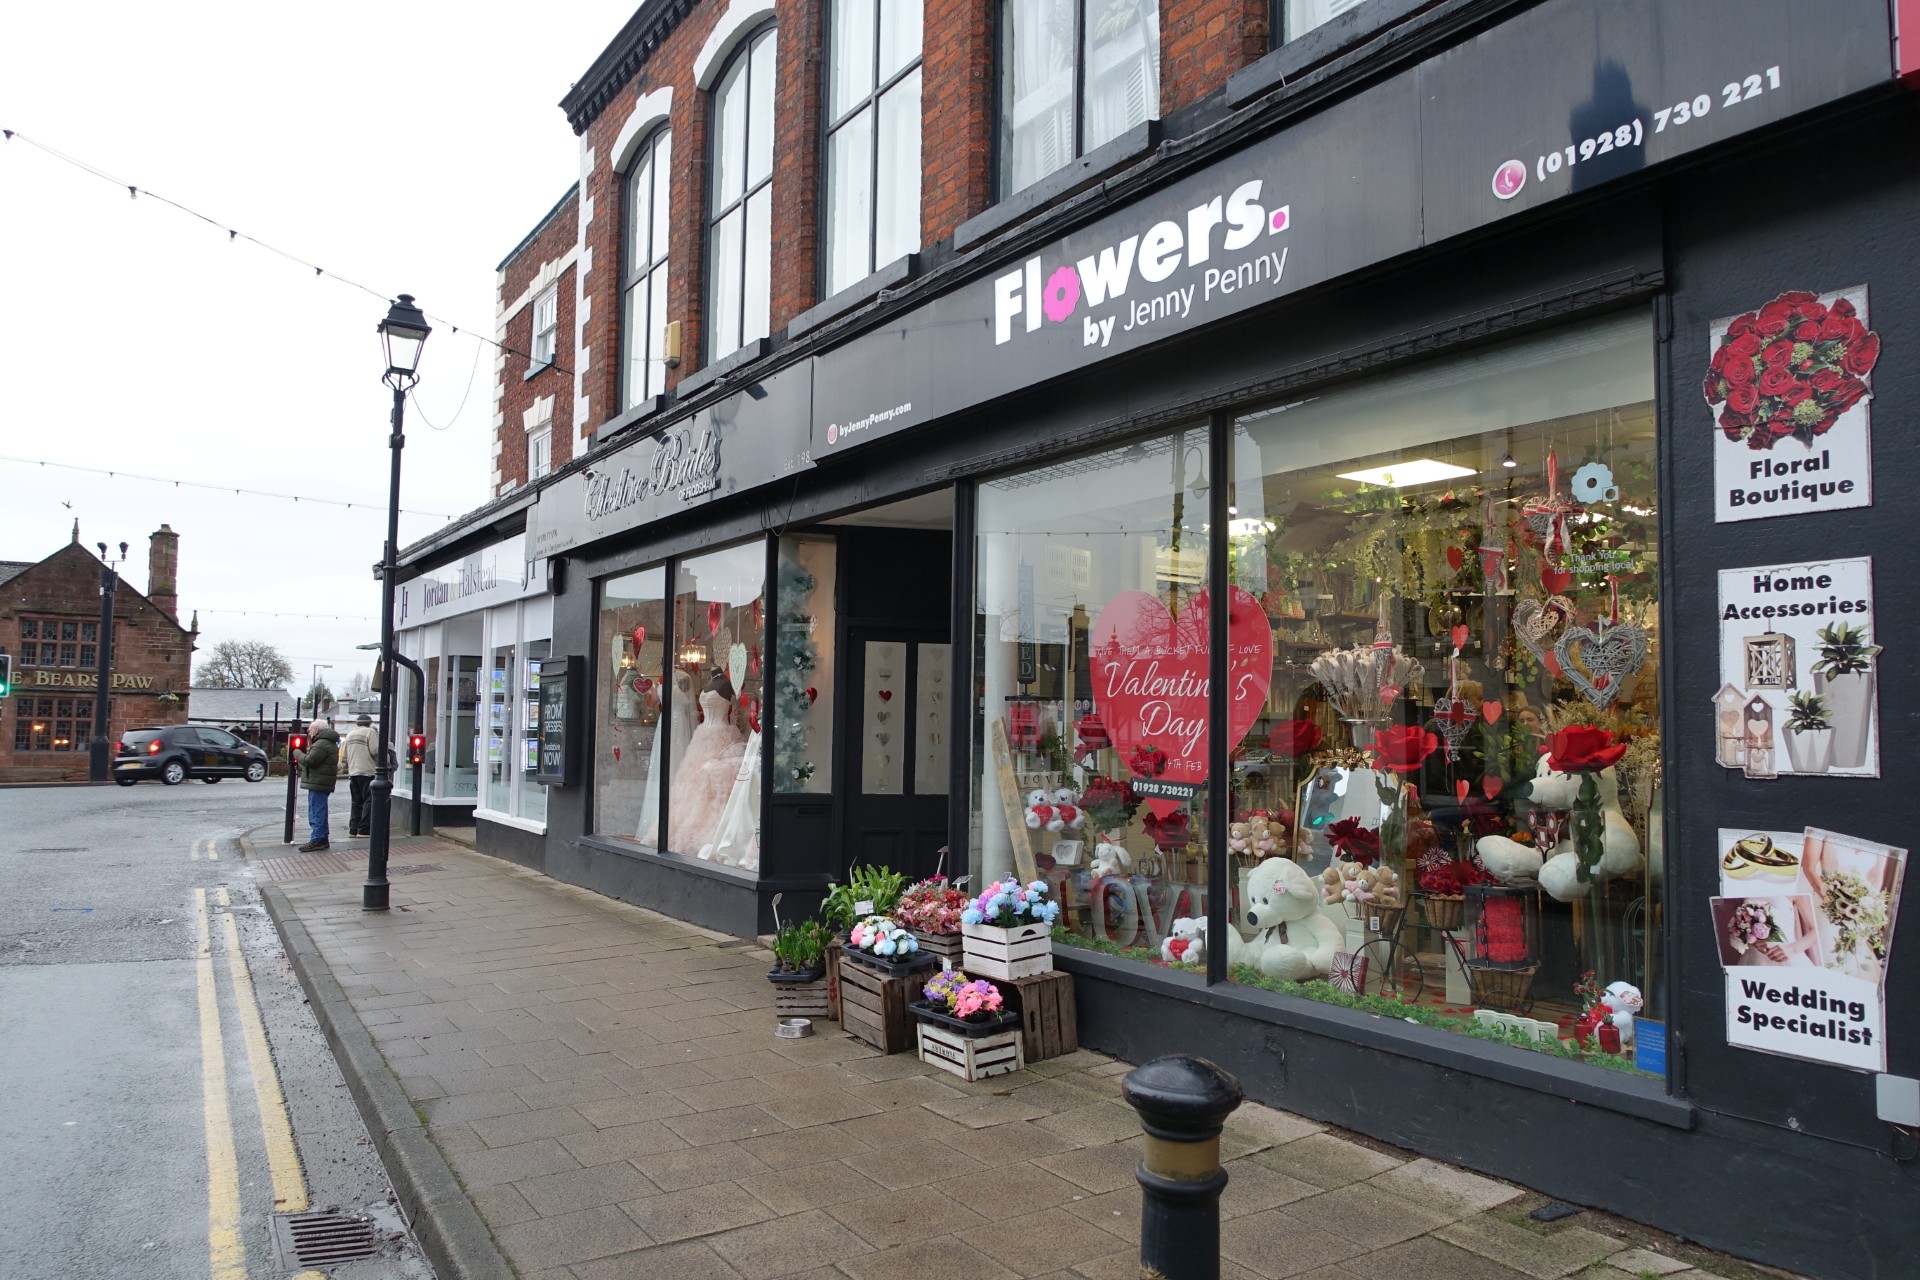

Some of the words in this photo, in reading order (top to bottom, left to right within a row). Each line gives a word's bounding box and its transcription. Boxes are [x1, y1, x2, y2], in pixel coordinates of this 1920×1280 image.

[1536, 118, 1644, 182] (01928)
[1653, 94, 1712, 134] 730
[1721, 65, 1781, 109] 221
[1083, 316, 1116, 348] by
[1124, 284, 1196, 331] Jenny
[1204, 247, 1289, 302] Penny
[839, 402, 912, 437] byJennyPenny.com
[1749, 450, 1831, 480] Floral
[1729, 478, 1855, 508] Boutique
[1554, 565, 1567, 575] for
[1569, 562, 1610, 576] shopping
[1611, 559, 1634, 570] local
[1570, 552, 1597, 563] Thank
[1599, 550, 1616, 560] You
[423, 576, 449, 616] Jordan
[456, 554, 498, 600] Halstead
[1753, 573, 1833, 594] Home
[1722, 595, 1868, 621] Accessories
[1118, 645, 1140, 656] THEM
[1155, 644, 1191, 655] BUCKET
[1238, 644, 1263, 654] LOVE
[35, 671, 99, 688] BEARS
[112, 673, 154, 689] PAW
[1139, 700, 1207, 757] Day
[543, 751, 562, 767] NOW
[1185, 760, 1202, 771] FEB
[1132, 781, 1159, 793] 01928
[1161, 784, 1194, 797] 730221
[1741, 978, 1866, 1023] Wedding
[1736, 1005, 1873, 1047] Specialist
